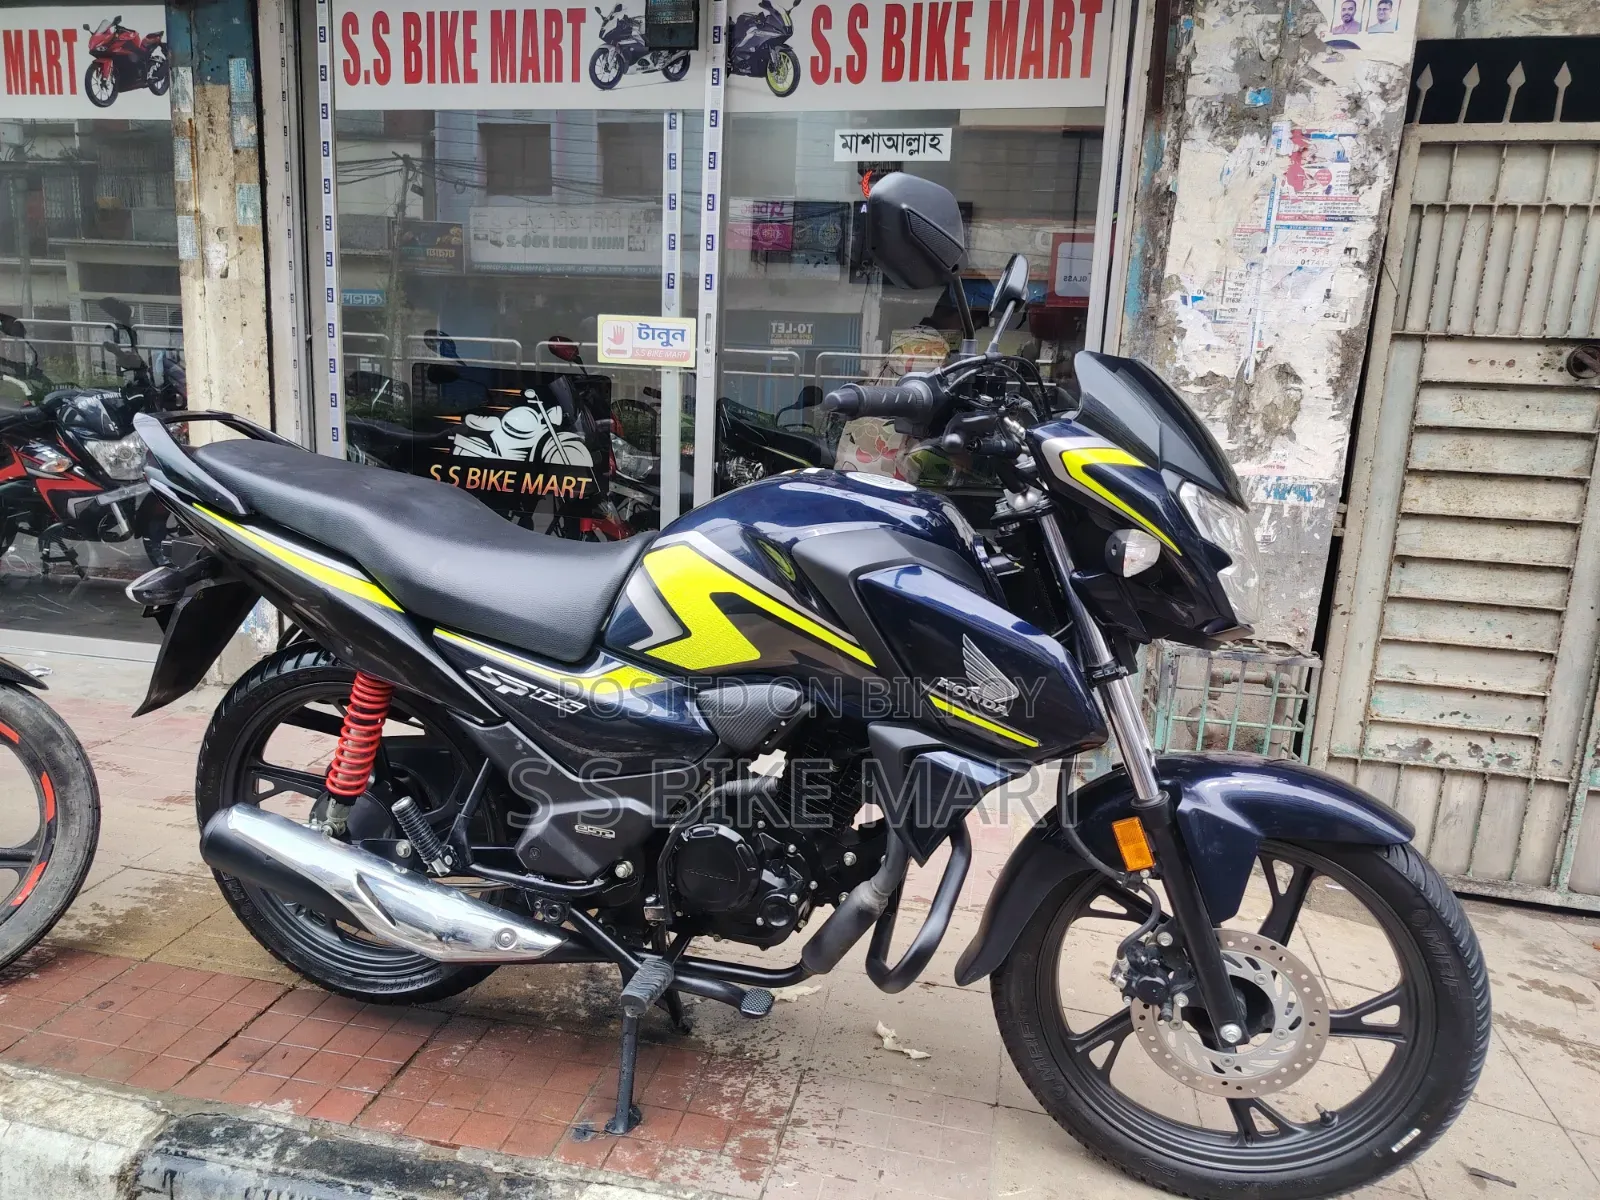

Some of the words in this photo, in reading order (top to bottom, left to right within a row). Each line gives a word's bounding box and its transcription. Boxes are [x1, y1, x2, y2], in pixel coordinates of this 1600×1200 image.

[342, 12, 391, 86] S.S
[404, 11, 477, 85] BIKE
[491, 9, 586, 83] MART
[811, 4, 868, 85] S.S
[882, 1, 973, 82] BIKE
[985, 0, 1102, 80] MART
[3, 29, 77, 95] MART
[839, 132, 944, 156] মাশাআল্লাহ
[637, 323, 686, 347] টানুন
[647, 349, 662, 358] BIKE
[664, 350, 687, 358] MART
[466, 467, 518, 493] BIKE
[520, 472, 592, 500] MART
[936, 677, 1010, 717] HONDA
